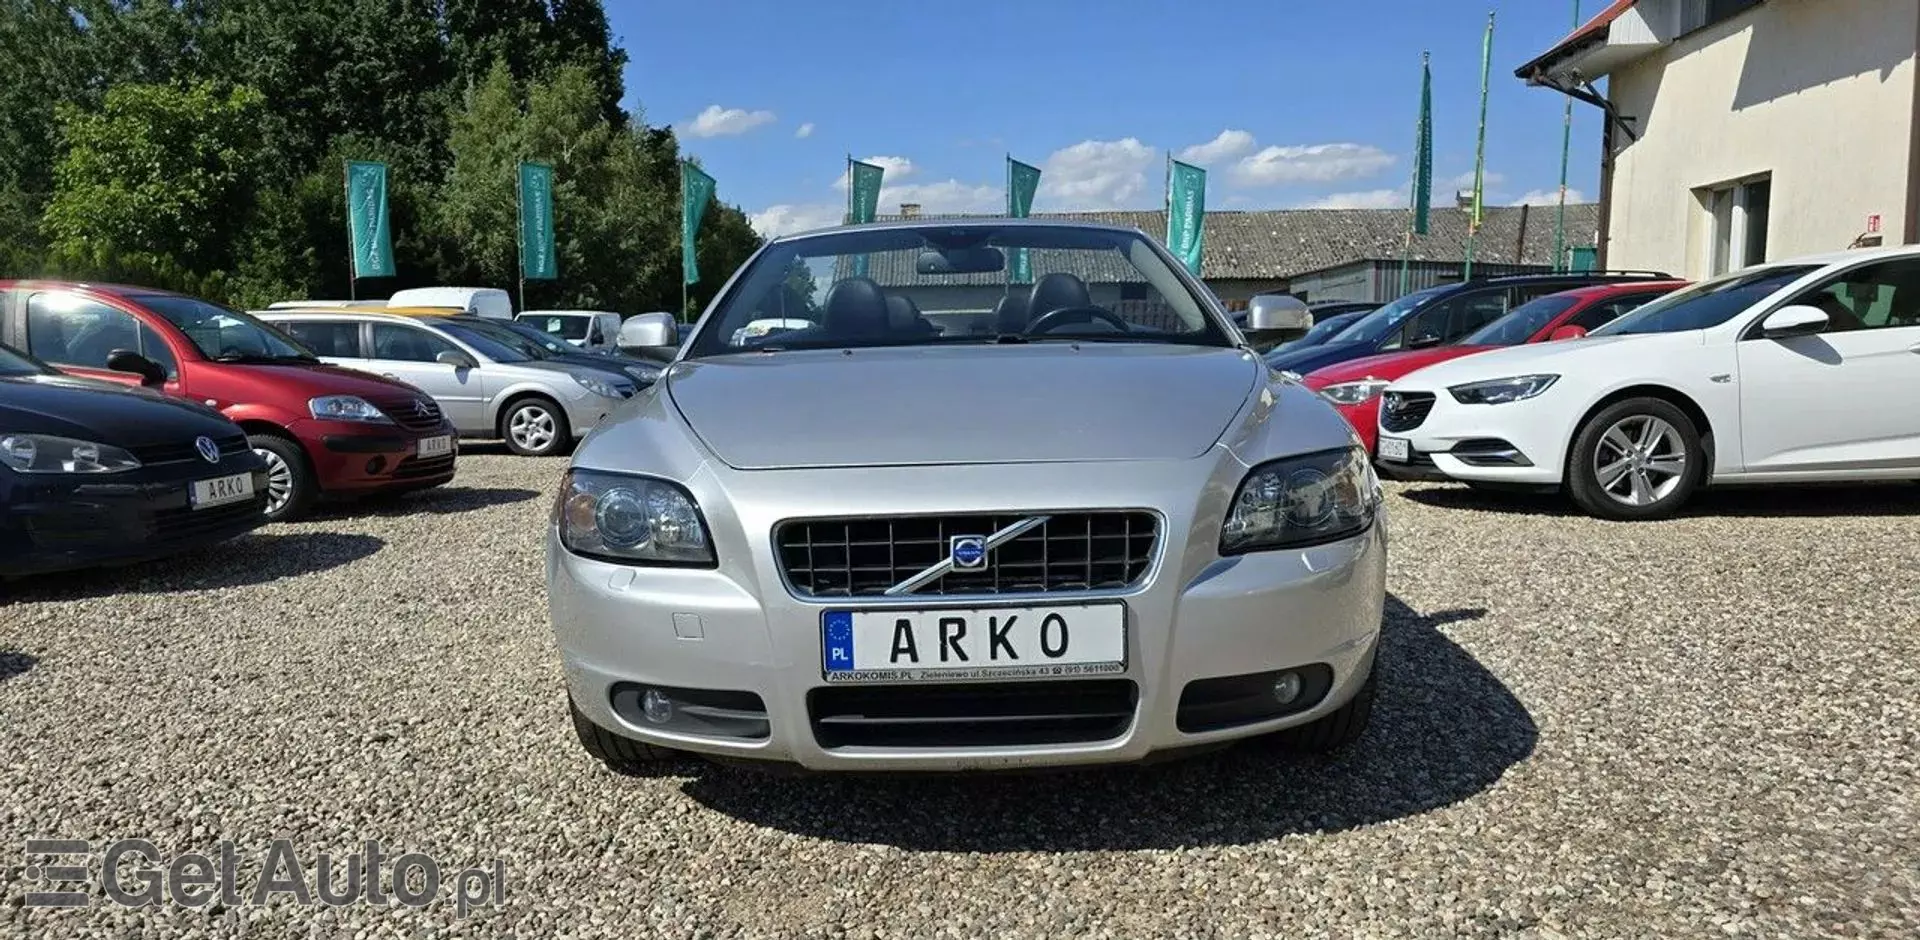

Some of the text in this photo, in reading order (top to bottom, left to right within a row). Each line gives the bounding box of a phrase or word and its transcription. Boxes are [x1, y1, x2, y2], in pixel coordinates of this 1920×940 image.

[208, 476, 243, 500] ARKO
[889, 612, 1070, 664] ARKO
[832, 648, 849, 662] PL
[831, 670, 913, 681] ARKOKOMIS.PL
[920, 670, 968, 679] Zieleniewo
[1039, 667, 1050, 676] 43
[1064, 665, 1081, 675] (91)
